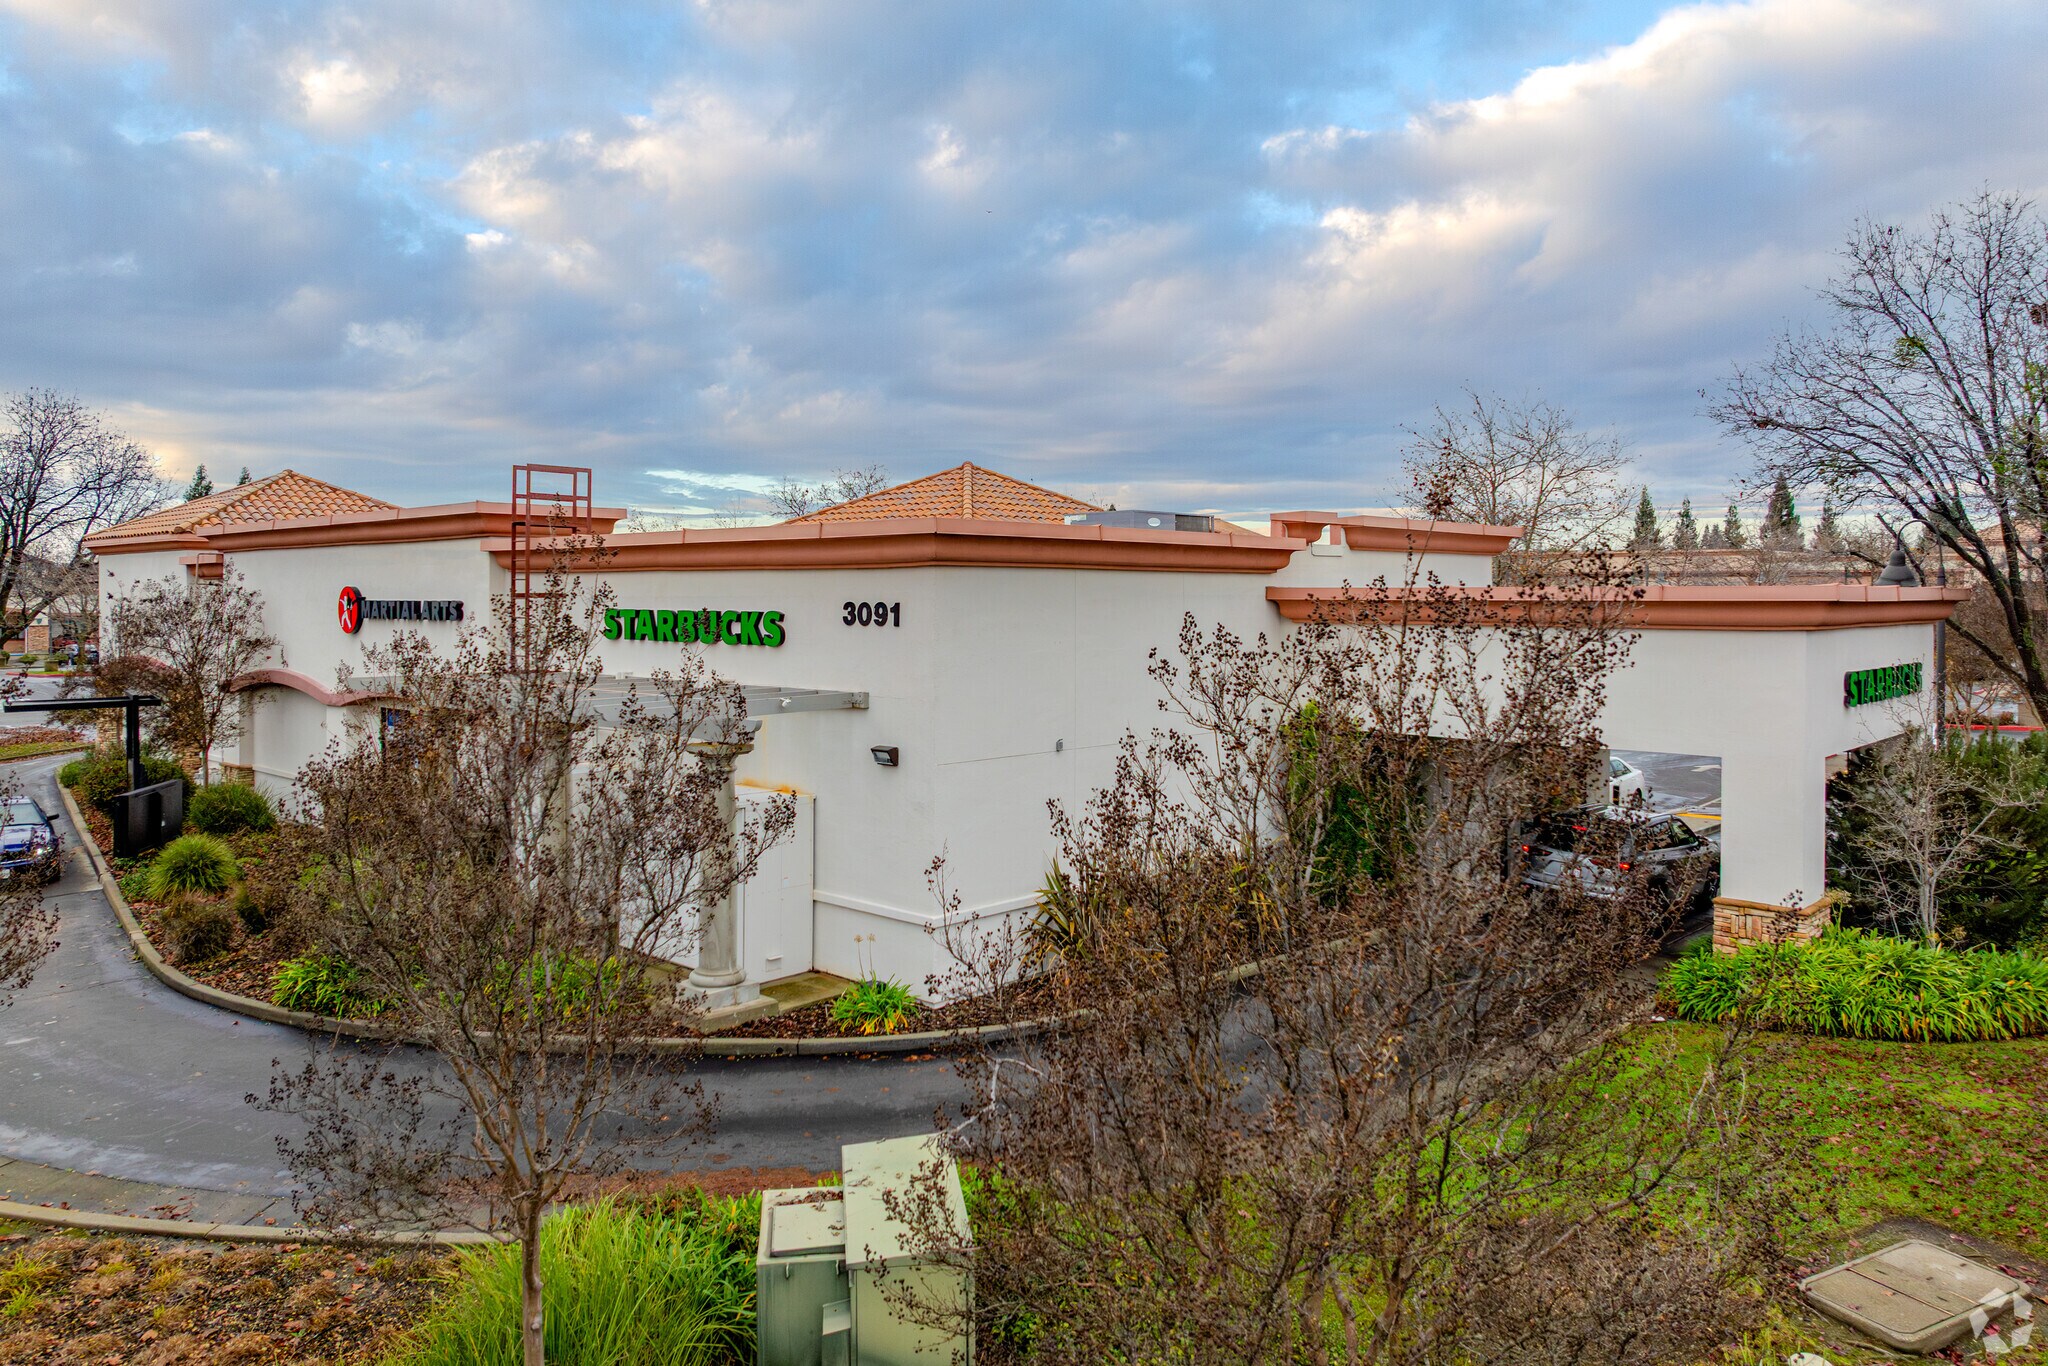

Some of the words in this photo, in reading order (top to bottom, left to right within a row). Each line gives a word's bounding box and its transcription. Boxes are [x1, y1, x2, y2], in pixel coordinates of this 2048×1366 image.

[361, 600, 420, 620] MARTIAL
[421, 600, 463, 621] ARTS
[842, 601, 900, 627] 3091
[604, 608, 785, 647] STARBUCKS
